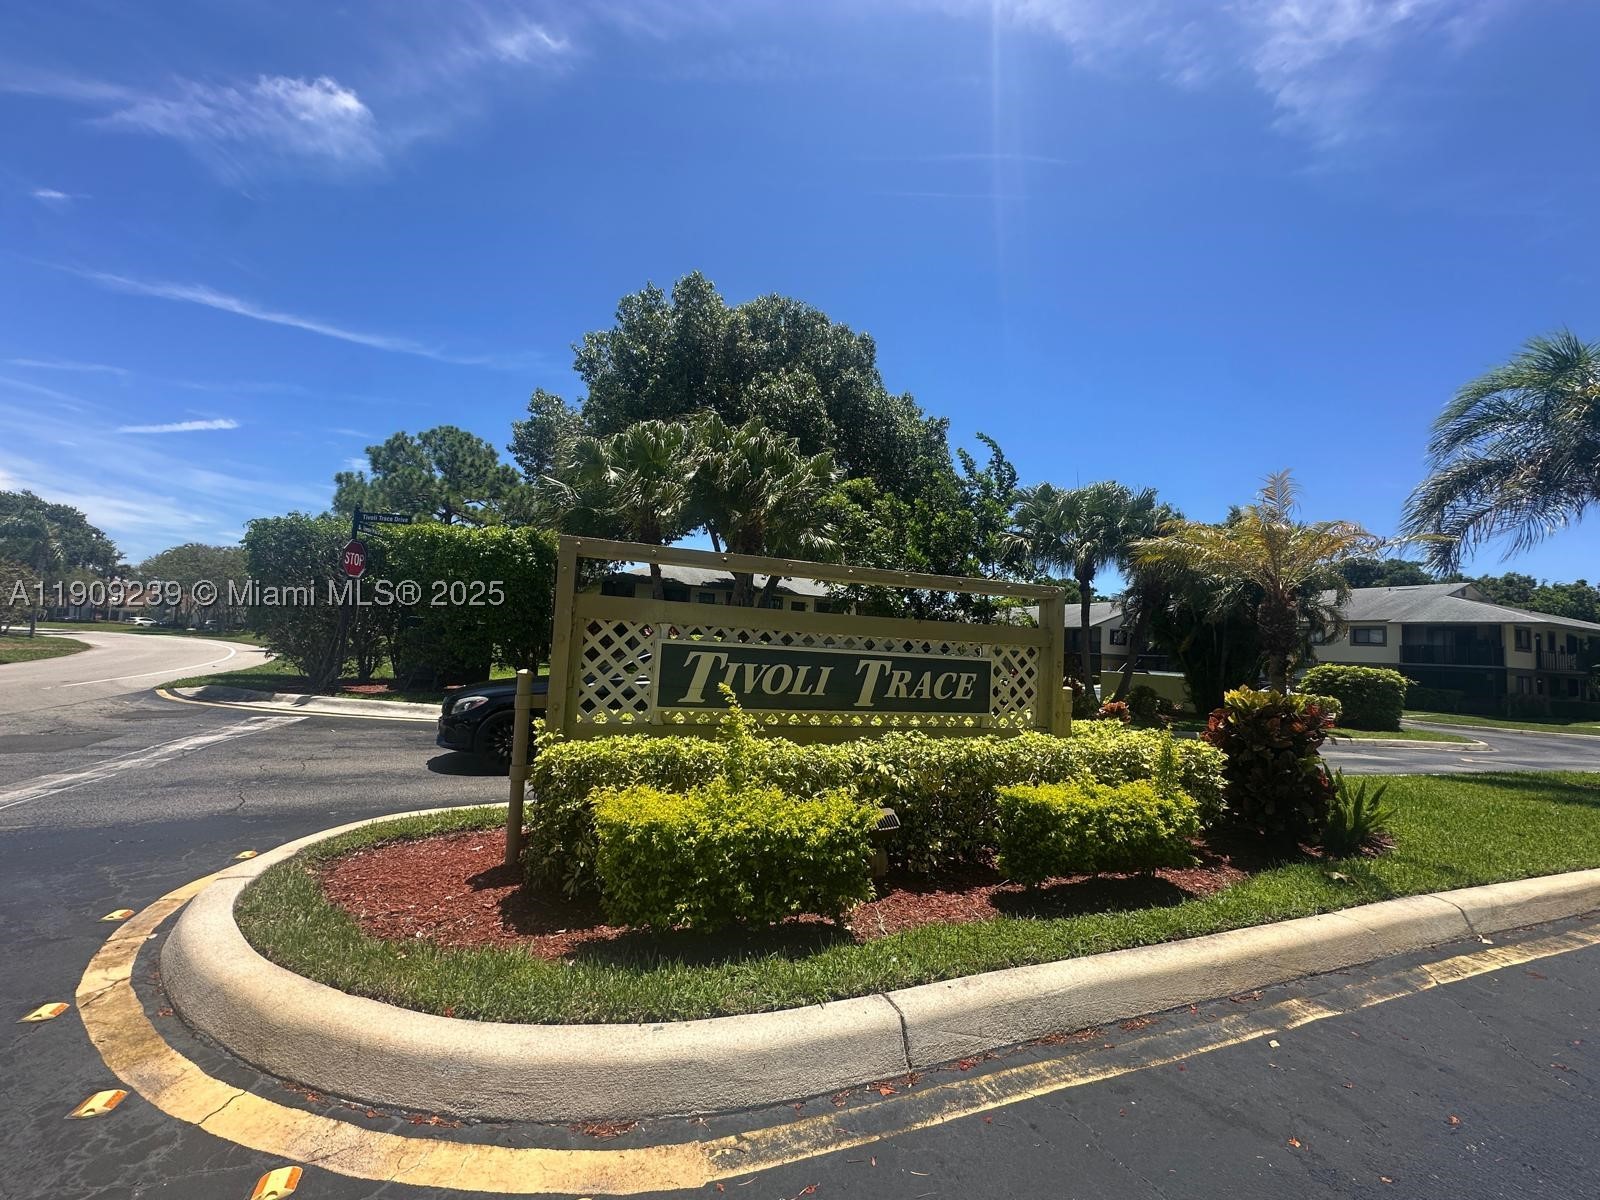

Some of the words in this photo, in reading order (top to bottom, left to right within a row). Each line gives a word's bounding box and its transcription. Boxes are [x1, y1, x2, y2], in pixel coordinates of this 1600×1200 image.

[344, 551, 364, 566] STOP
[677, 651, 834, 704] TIVOLI
[853, 659, 978, 707] TRACE
